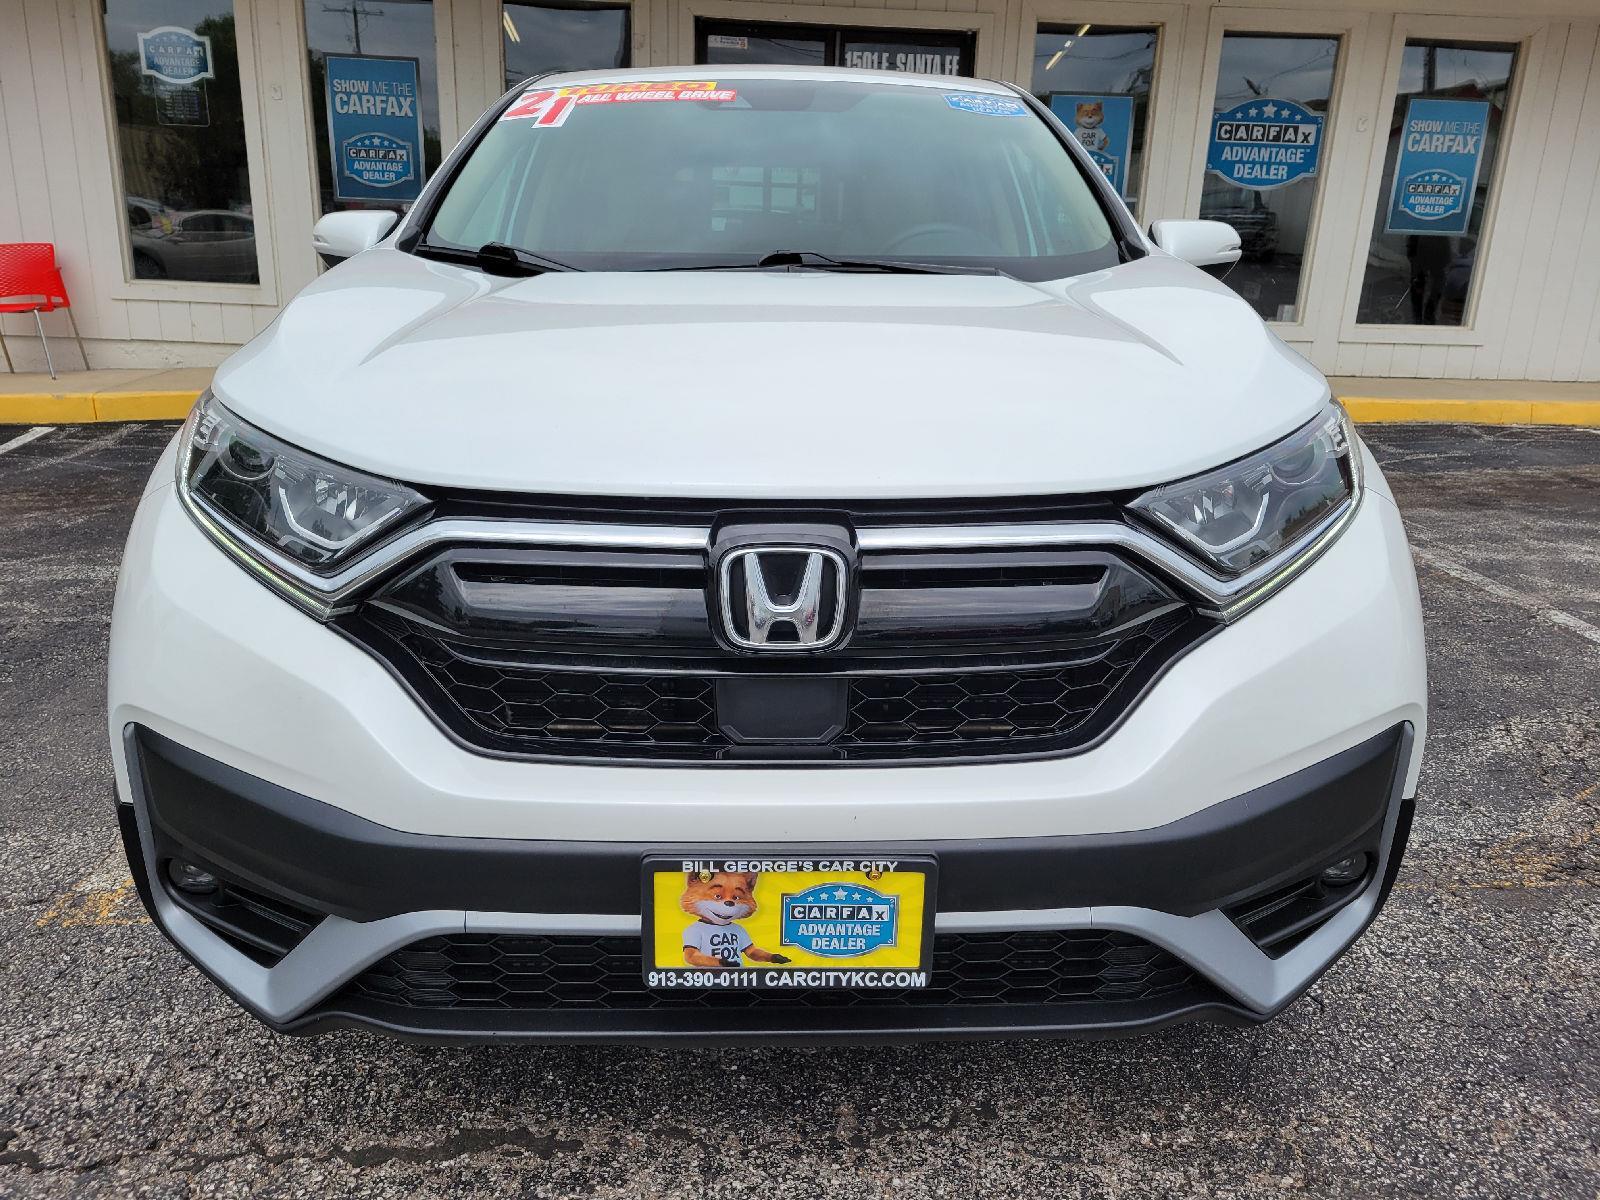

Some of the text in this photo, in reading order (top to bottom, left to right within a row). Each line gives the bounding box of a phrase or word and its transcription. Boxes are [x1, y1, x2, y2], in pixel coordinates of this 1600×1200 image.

[153, 55, 200, 66] ADVANTAGE
[896, 53, 942, 75] SANTA
[162, 65, 194, 76] DEALER
[333, 79, 413, 96] SHOW ME THE
[577, 90, 735, 104] ALL WHEEL DRIVE
[335, 93, 415, 117] CARFAX
[501, 89, 576, 127] 21
[1409, 119, 1480, 135] SHOW ME THE
[1081, 131, 1097, 139] CAR
[1219, 124, 1312, 144] CARFAX
[1081, 139, 1095, 147] FOX
[1407, 132, 1479, 154] CARFAX
[349, 148, 406, 161] CARFAX
[1221, 146, 1305, 163] ADVANTAGE
[353, 160, 403, 172] ADVANTAGE
[1233, 163, 1288, 180] DEALER
[363, 171, 396, 181] DEALER
[1408, 184, 1459, 196] CARFAX
[1408, 195, 1454, 206] ADVANTAGE
[1415, 204, 1445, 214] DEALER
[682, 861, 898, 873] BILL GEORGE'S CAR CITY
[793, 906, 885, 920] CARFAX
[797, 923, 881, 936] ADVANTAGE
[709, 933, 739, 946] CAR
[811, 937, 866, 950] DEALER
[711, 947, 740, 960] FOX
[648, 971, 926, 987] 913-390-0111 CARCITYKC.COM
